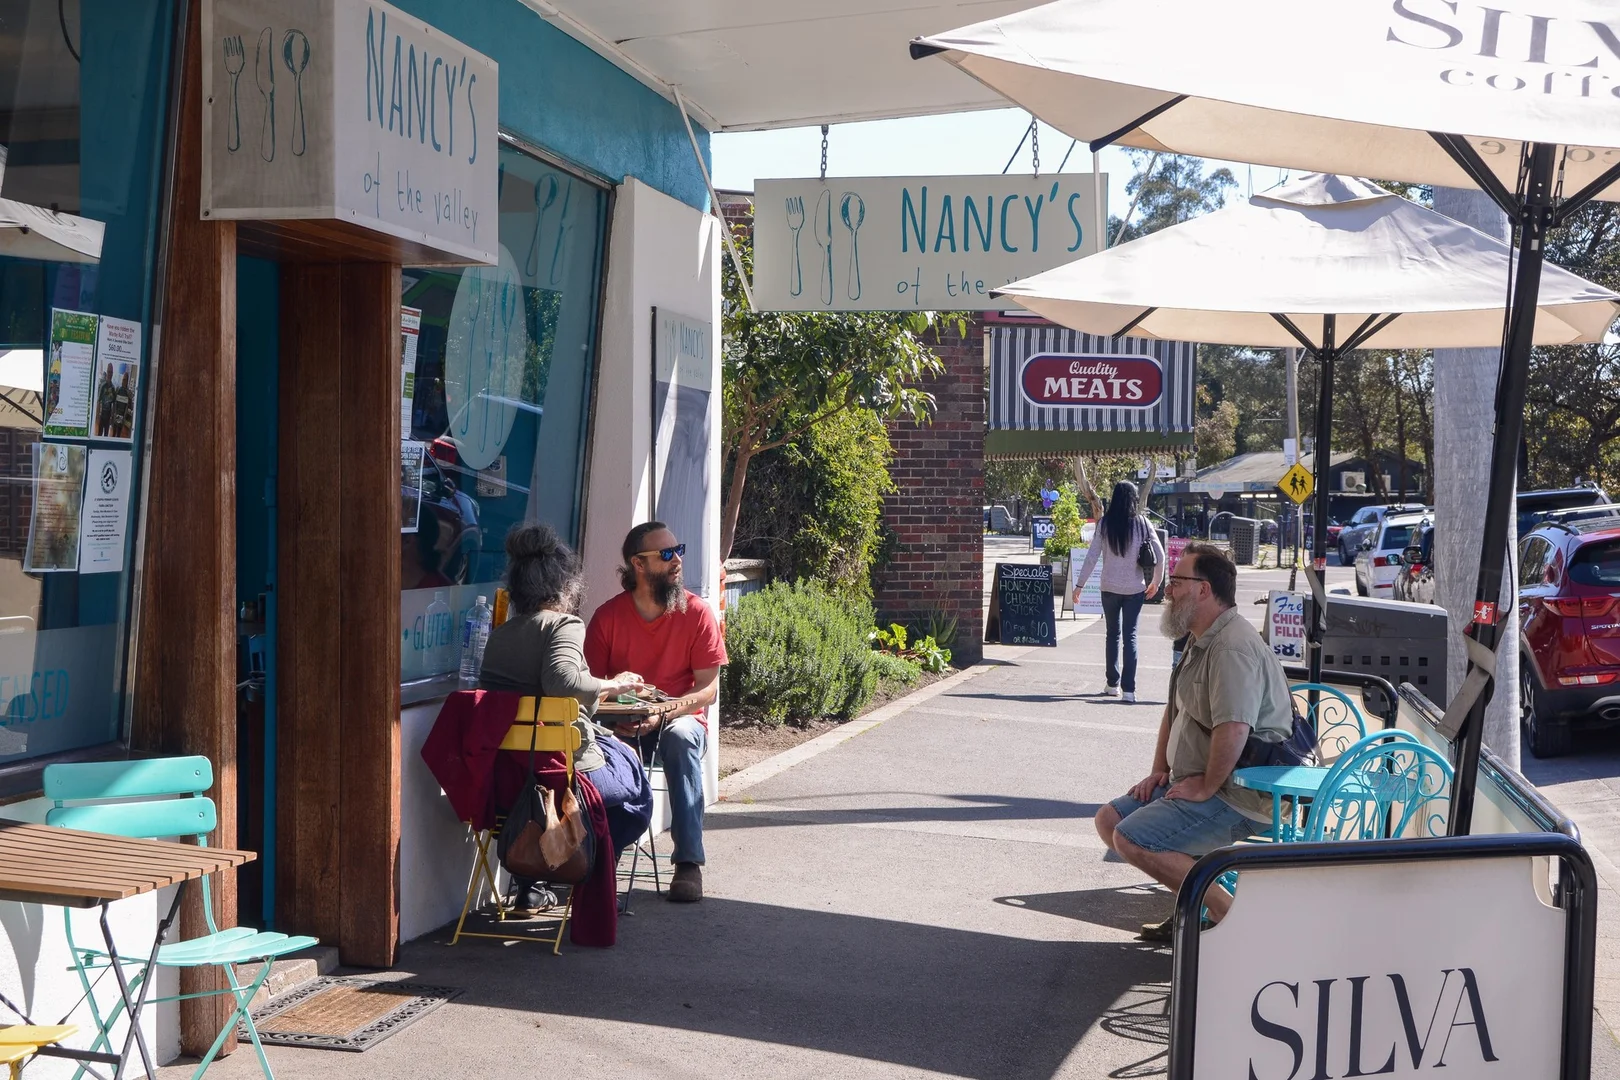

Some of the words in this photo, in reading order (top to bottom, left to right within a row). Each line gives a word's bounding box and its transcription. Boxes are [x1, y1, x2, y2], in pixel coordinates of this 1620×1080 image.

[366, 6, 478, 165] NANCY'S
[1439, 68, 1620, 98] coff
[363, 151, 381, 219] of
[397, 169, 423, 213] the
[434, 187, 479, 244] valley
[901, 181, 1083, 254] NANCY'S
[897, 267, 921, 305] of
[947, 270, 986, 297] the
[680, 321, 704, 359] NANCY'S
[1069, 361, 1118, 379] Quality
[1043, 377, 1143, 400] MEATS
[999, 580, 1031, 592] HONEY
[1034, 581, 1052, 595] SOY
[1005, 592, 1043, 605] CHICKEN
[1009, 604, 1040, 616] STICKS
[413, 612, 454, 650] GLUTEN
[1030, 619, 1049, 638] $10
[1248, 967, 1500, 1080] SILVA
